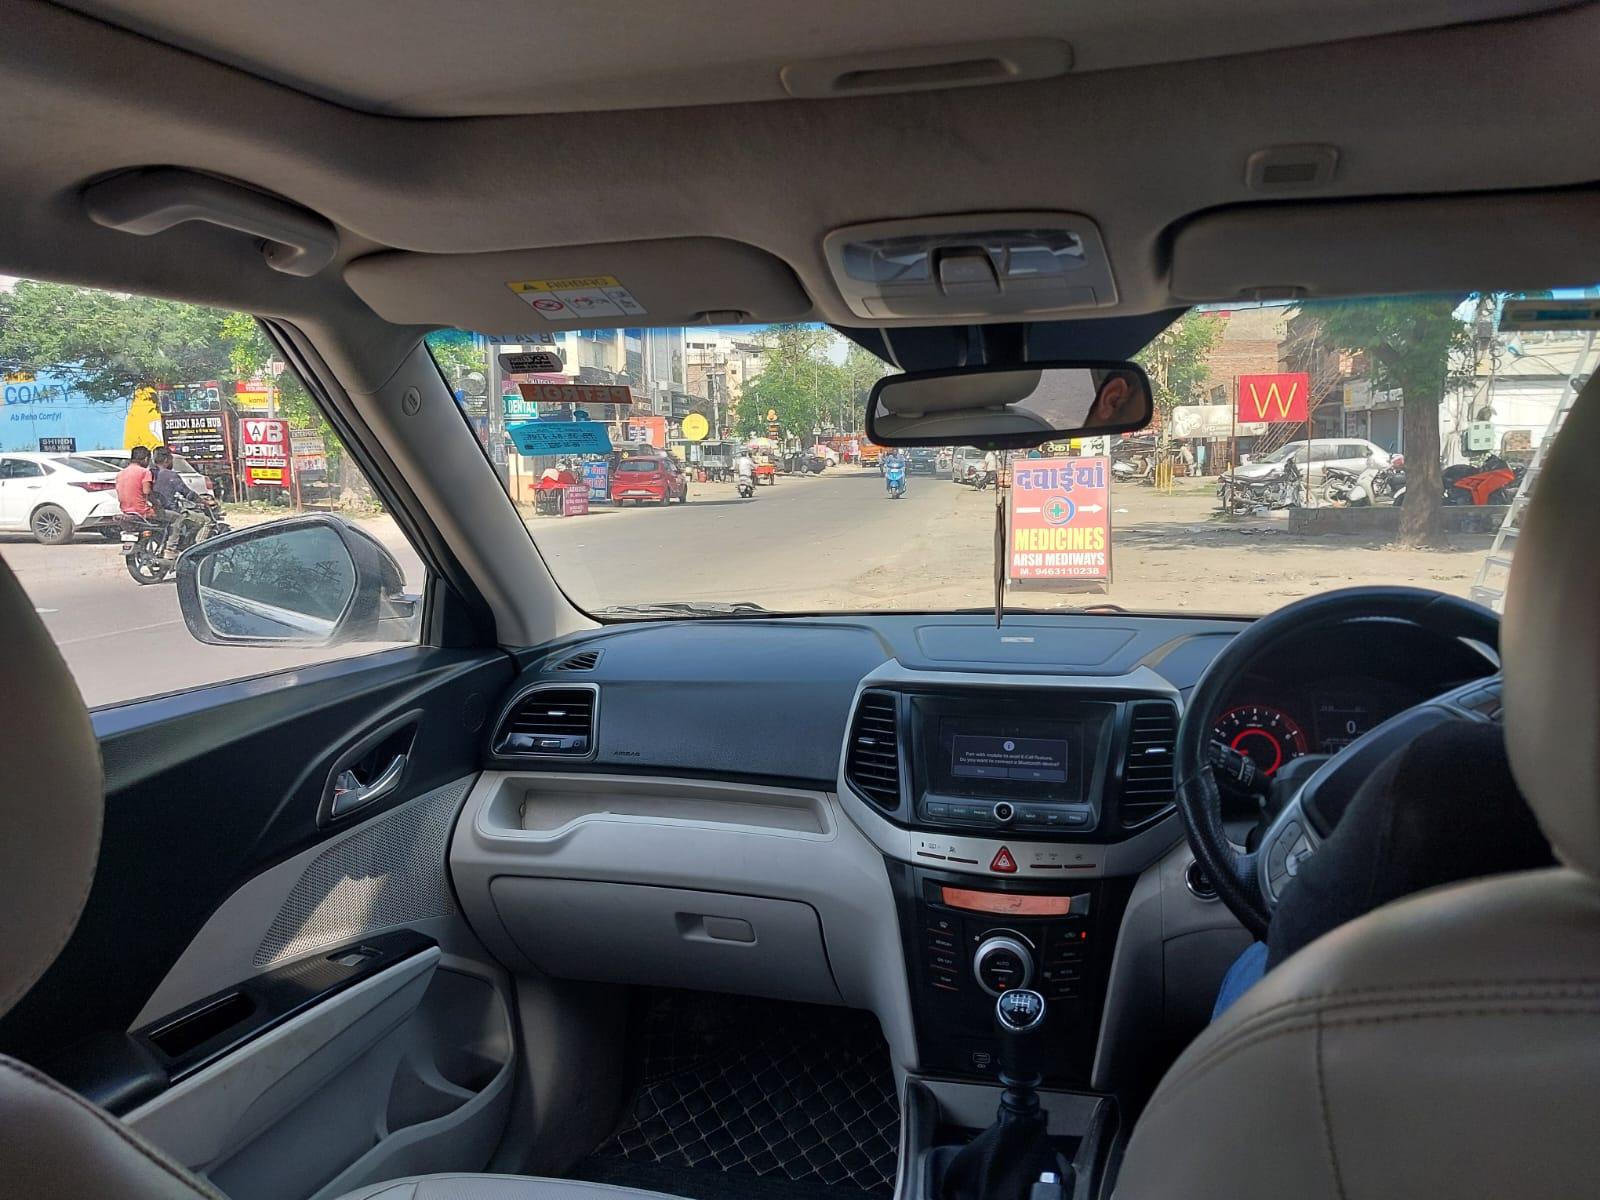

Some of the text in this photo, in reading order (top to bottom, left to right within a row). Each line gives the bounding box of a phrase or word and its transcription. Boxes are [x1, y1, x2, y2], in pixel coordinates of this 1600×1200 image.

[507, 399, 536, 413] DENTAL
[1249, 383, 1297, 418] W
[165, 417, 222, 430] SHINDI BAG HUB
[245, 444, 286, 457] DENTAL
[1014, 527, 1105, 551] MEDICINES
[1013, 552, 1105, 566] ARSH MEDIWAYS
[1346, 720, 1357, 734] 0
